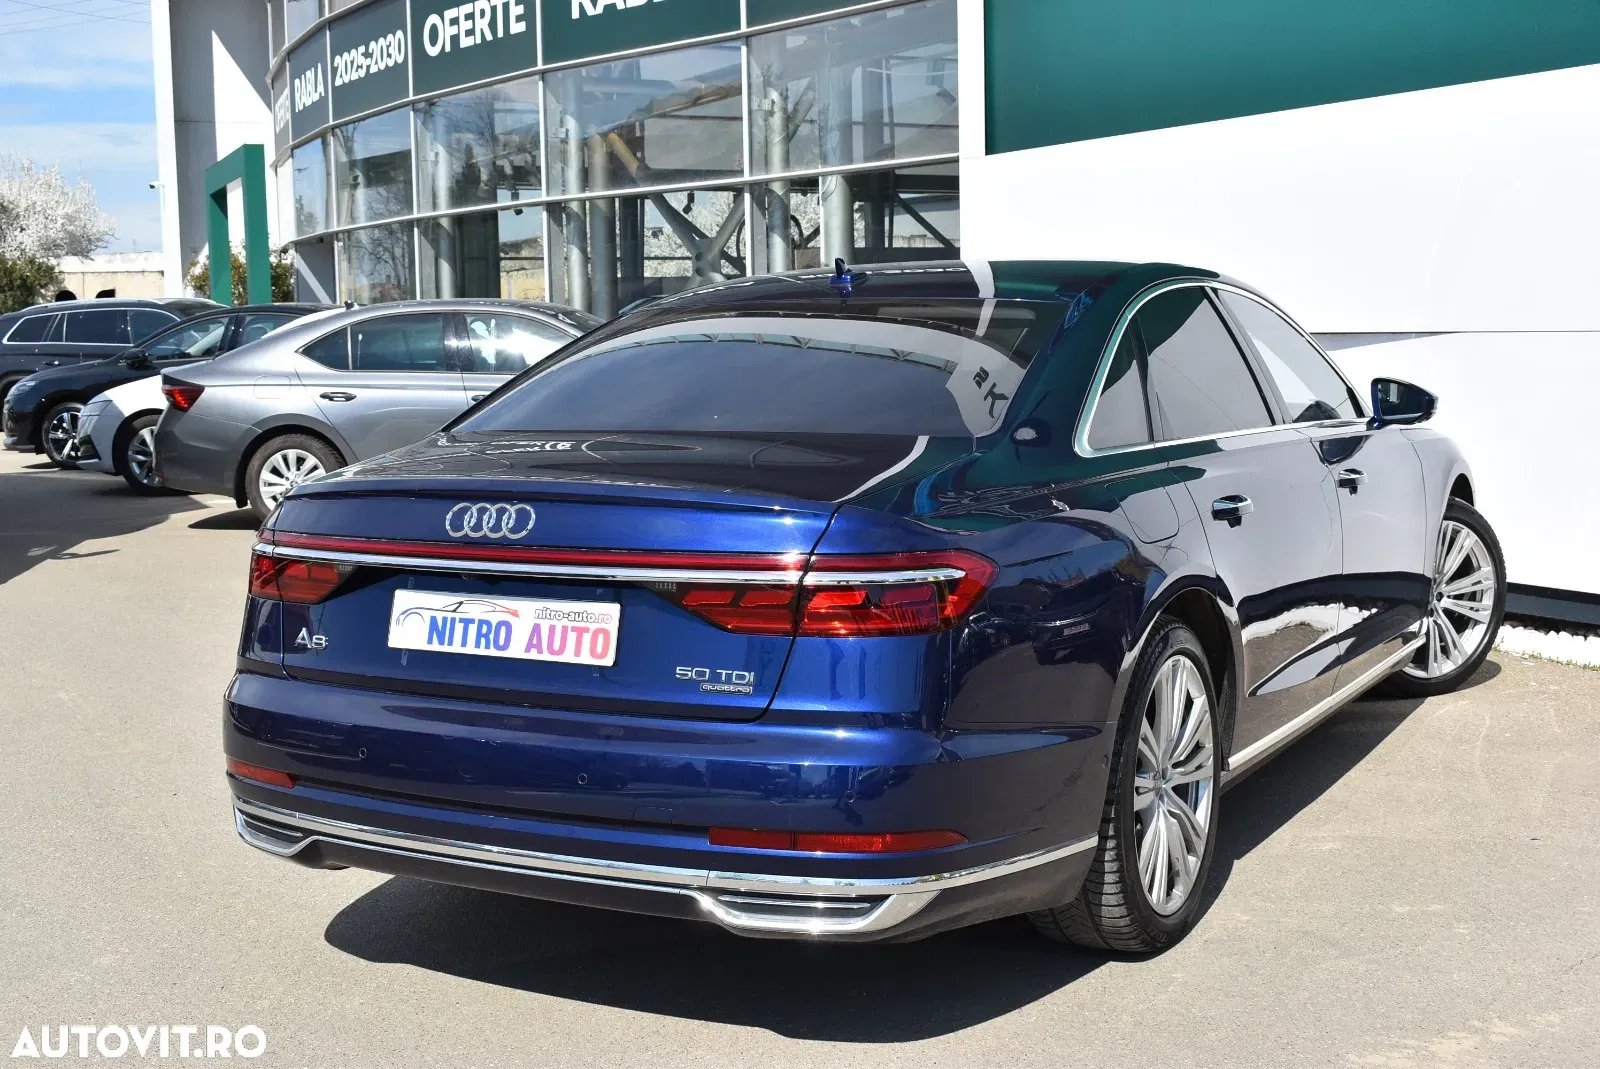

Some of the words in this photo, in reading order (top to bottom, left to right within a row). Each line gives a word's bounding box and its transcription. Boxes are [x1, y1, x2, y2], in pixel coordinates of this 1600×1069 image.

[423, 0, 527, 57] OFERTE
[333, 29, 405, 87] 2025-2030
[294, 62, 325, 113] RABLA
[534, 606, 613, 624] nitro-auto.ro
[293, 626, 326, 650] A8
[426, 615, 513, 651] NITRO
[524, 622, 611, 659] AUTO
[675, 666, 710, 681] 50
[716, 669, 755, 685] TDI
[702, 683, 751, 693] quattro
